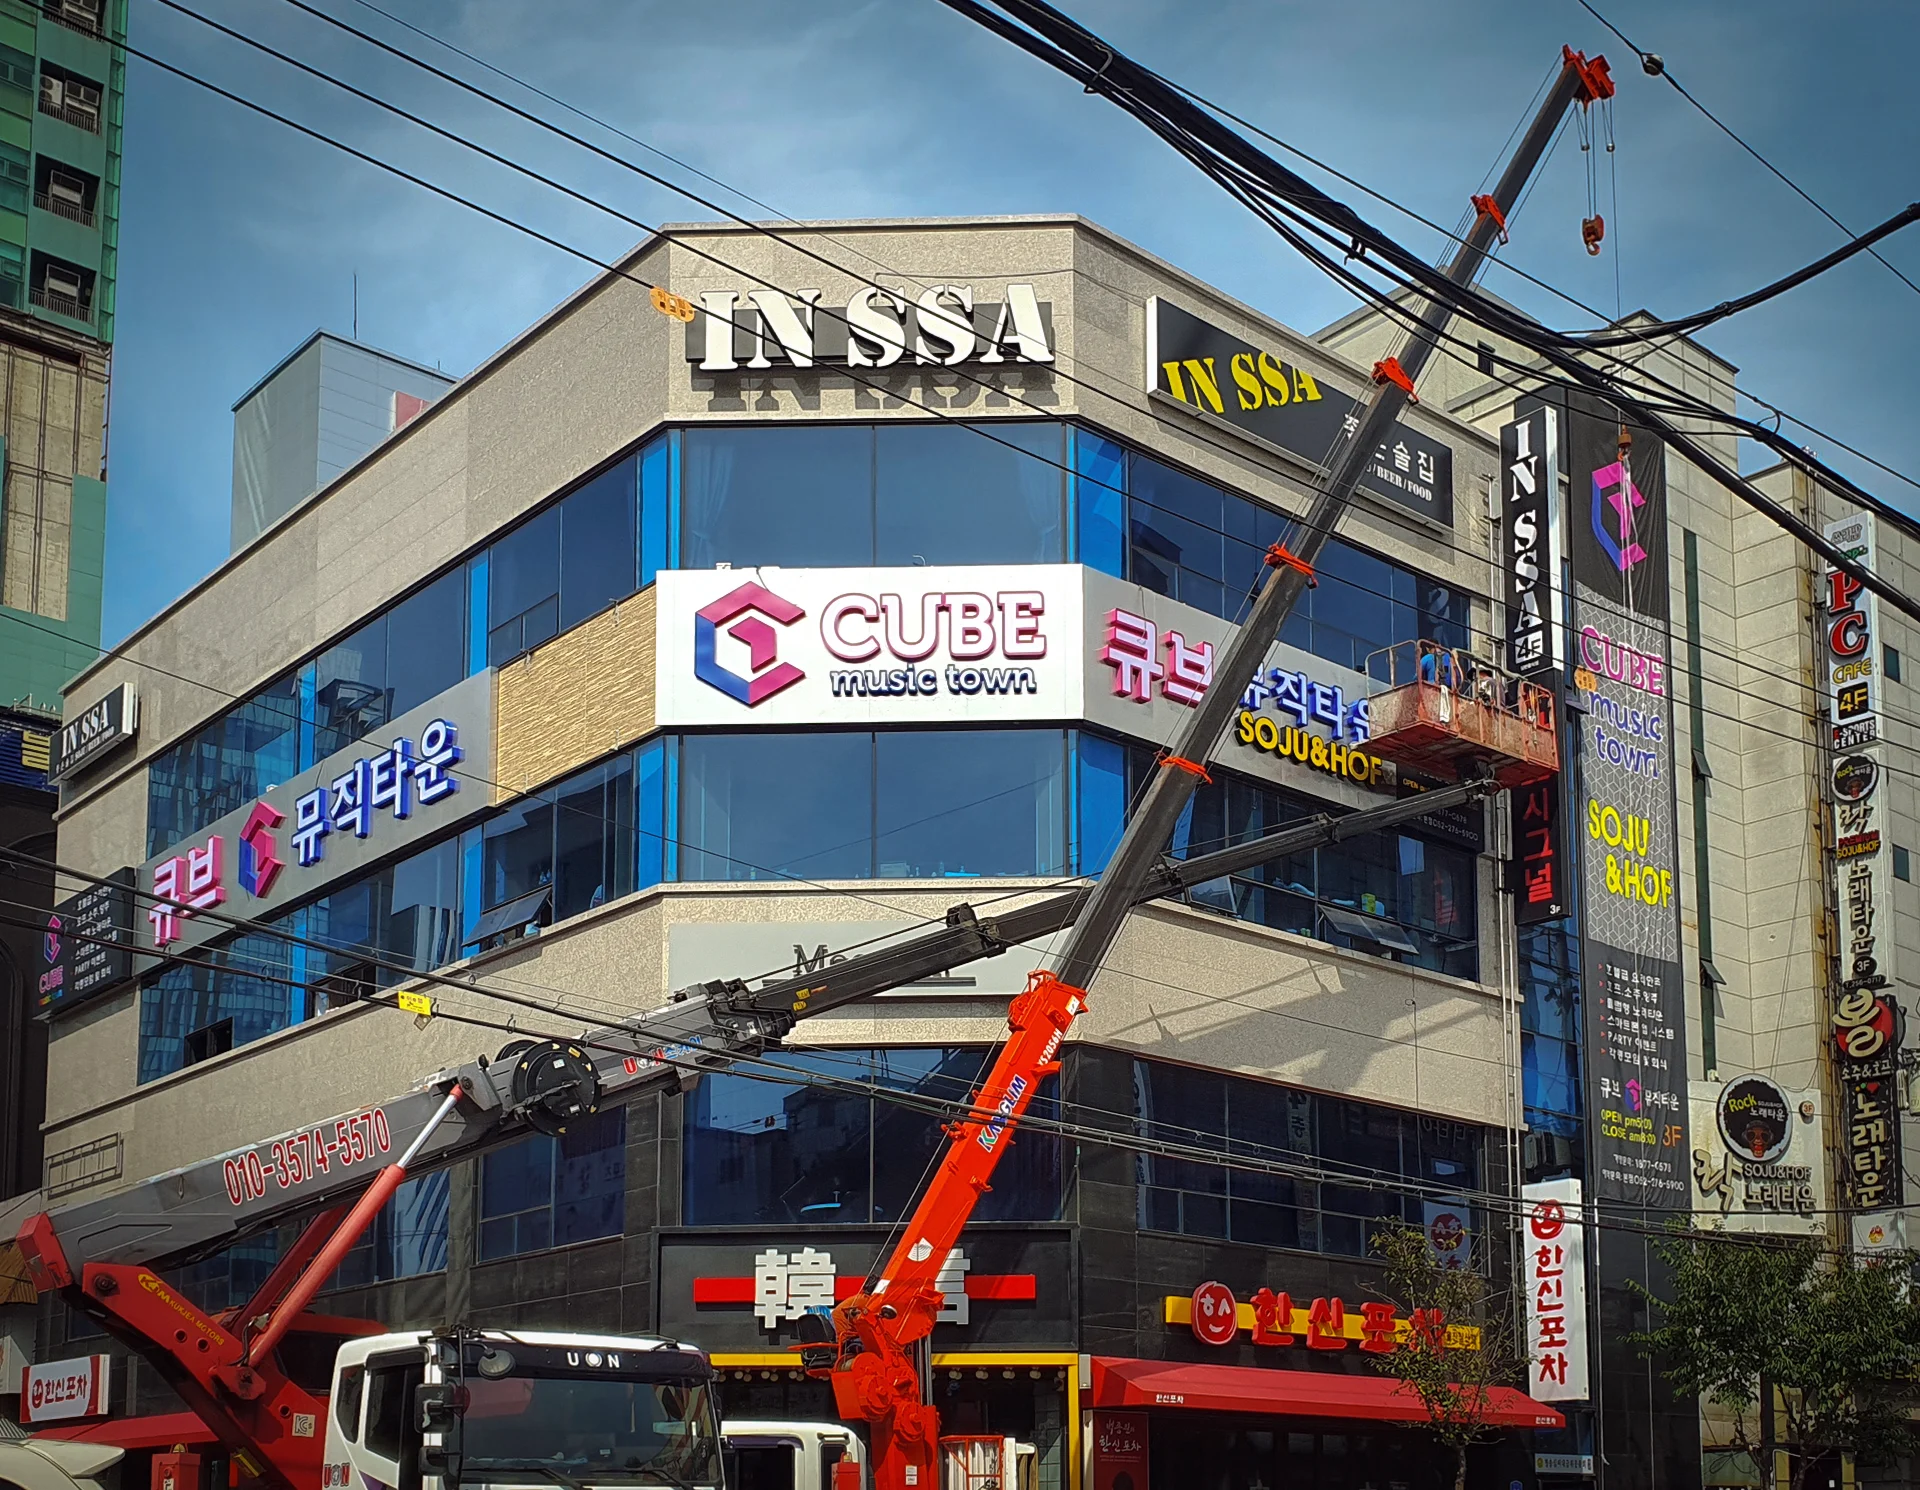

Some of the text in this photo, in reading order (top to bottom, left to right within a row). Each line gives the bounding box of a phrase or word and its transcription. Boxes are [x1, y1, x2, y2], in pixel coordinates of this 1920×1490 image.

[699, 283, 1055, 370] IN SSA
[1162, 352, 1323, 414] IN SSA
[1510, 420, 1538, 502] IN
[1513, 509, 1543, 634] SSA
[820, 592, 1048, 663] CUBE
[1517, 637, 1541, 659] 4F
[831, 664, 1037, 697] music town
[1102, 608, 1217, 706] 큐브
[1581, 625, 1665, 697] CUBE
[1832, 657, 1873, 685] CAFE
[1588, 690, 1663, 743] music
[1839, 687, 1868, 712] 4F
[62, 699, 110, 759] IN SSA
[1239, 710, 1384, 787] SOJU&HOF
[1596, 726, 1659, 779] town
[1833, 730, 1876, 749] CENTER
[291, 721, 463, 868] 뮤직타운
[1523, 788, 1554, 903] 시그널
[1587, 799, 1650, 858] SOJU
[1836, 840, 1880, 859] SOJU&HOF
[149, 834, 226, 947] 큐브
[1604, 852, 1673, 909] &HOF
[1848, 858, 1874, 954] 노래타운
[1550, 905, 1562, 918] 3F
[1856, 959, 1871, 972] 3F
[1607, 1030, 1633, 1047] PARTY
[1600, 1077, 1622, 1099] 큐브
[1728, 1093, 1758, 1113] Rock
[1749, 1107, 1786, 1122] 노래타운
[223, 1107, 391, 1206] 010-3574-5570
[1601, 1123, 1627, 1141] CLOSE
[1662, 1124, 1683, 1148] 3F
[1852, 1092, 1893, 1208] 노래타운
[1693, 1148, 1744, 1213] 락
[1744, 1163, 1813, 1181] SOJU&HOF
[1746, 1184, 1818, 1213] 노래타운
[1532, 1244, 1568, 1386] 한신포차
[44, 1373, 88, 1405] 한신포차
